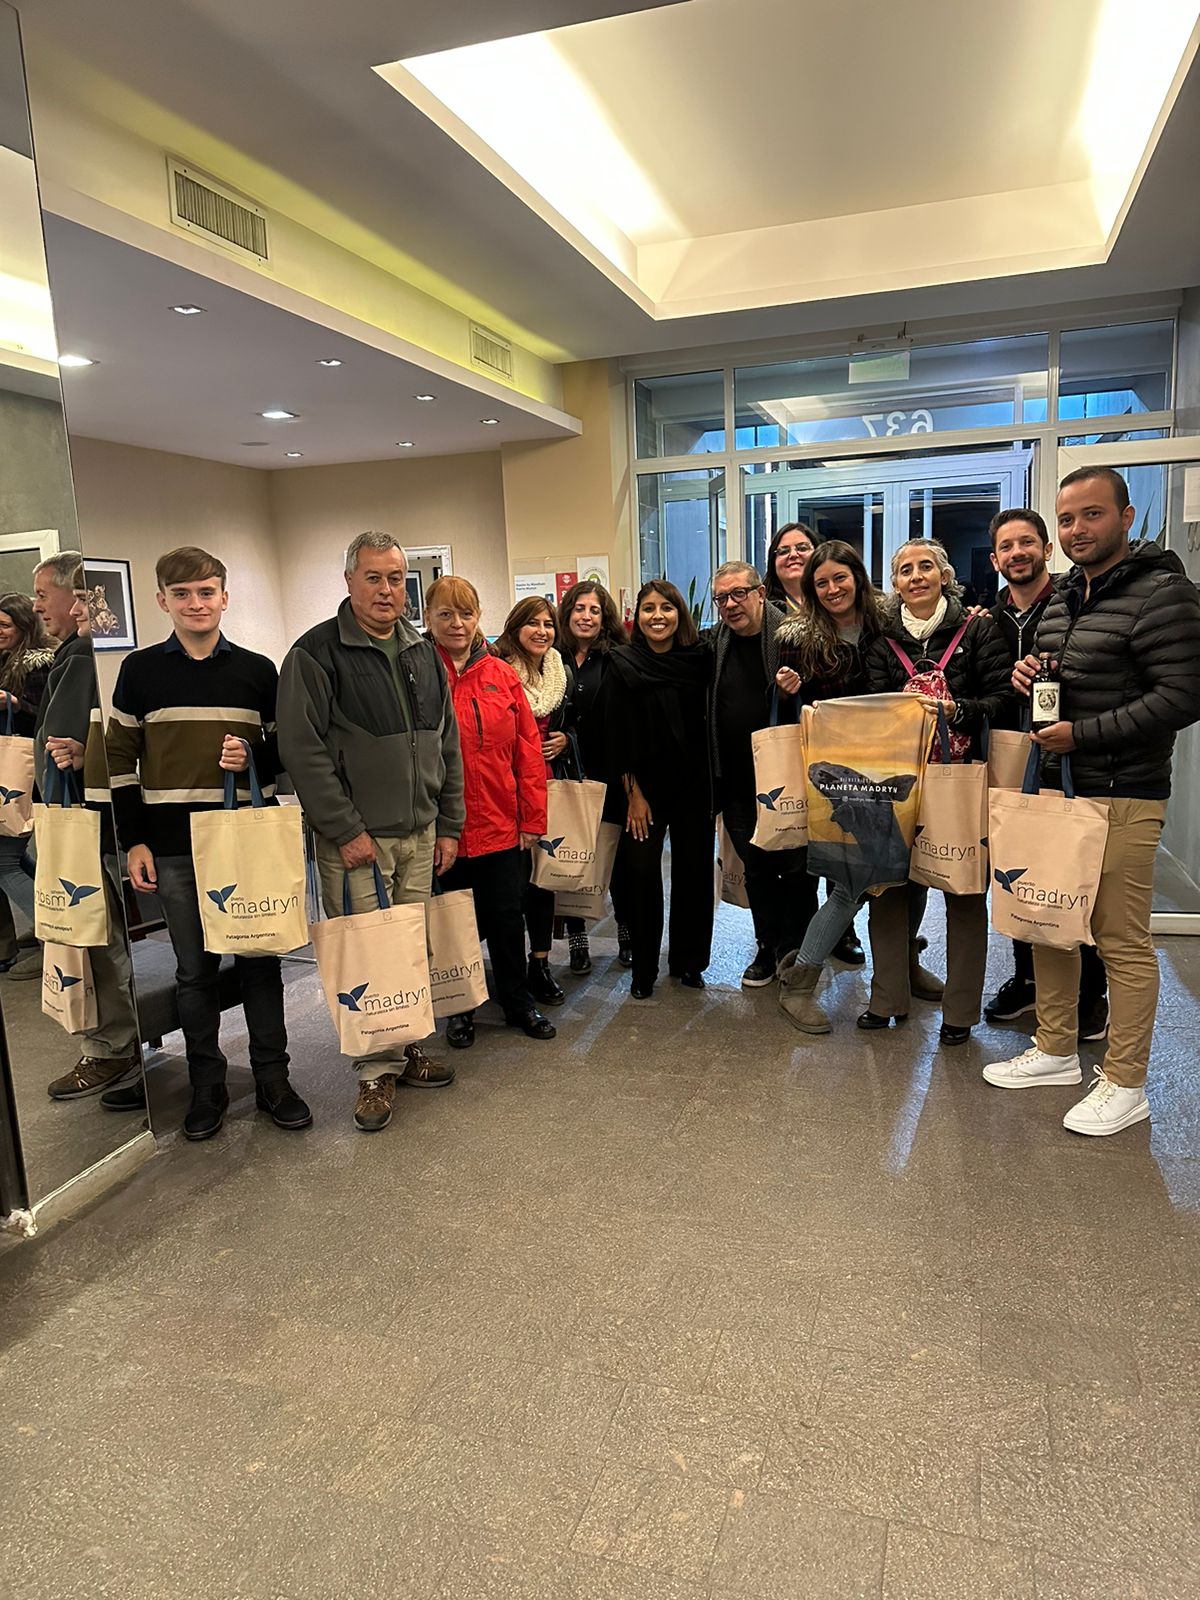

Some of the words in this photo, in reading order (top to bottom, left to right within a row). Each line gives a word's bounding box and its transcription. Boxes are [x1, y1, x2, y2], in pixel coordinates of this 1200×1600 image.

[820, 783, 859, 792] PLANETA
[860, 785, 898, 794] MADRYN
[920, 840, 976, 861] madryn
[231, 896, 298, 914] madryn
[1016, 886, 1089, 910] madryn
[364, 986, 429, 1011] madryn
